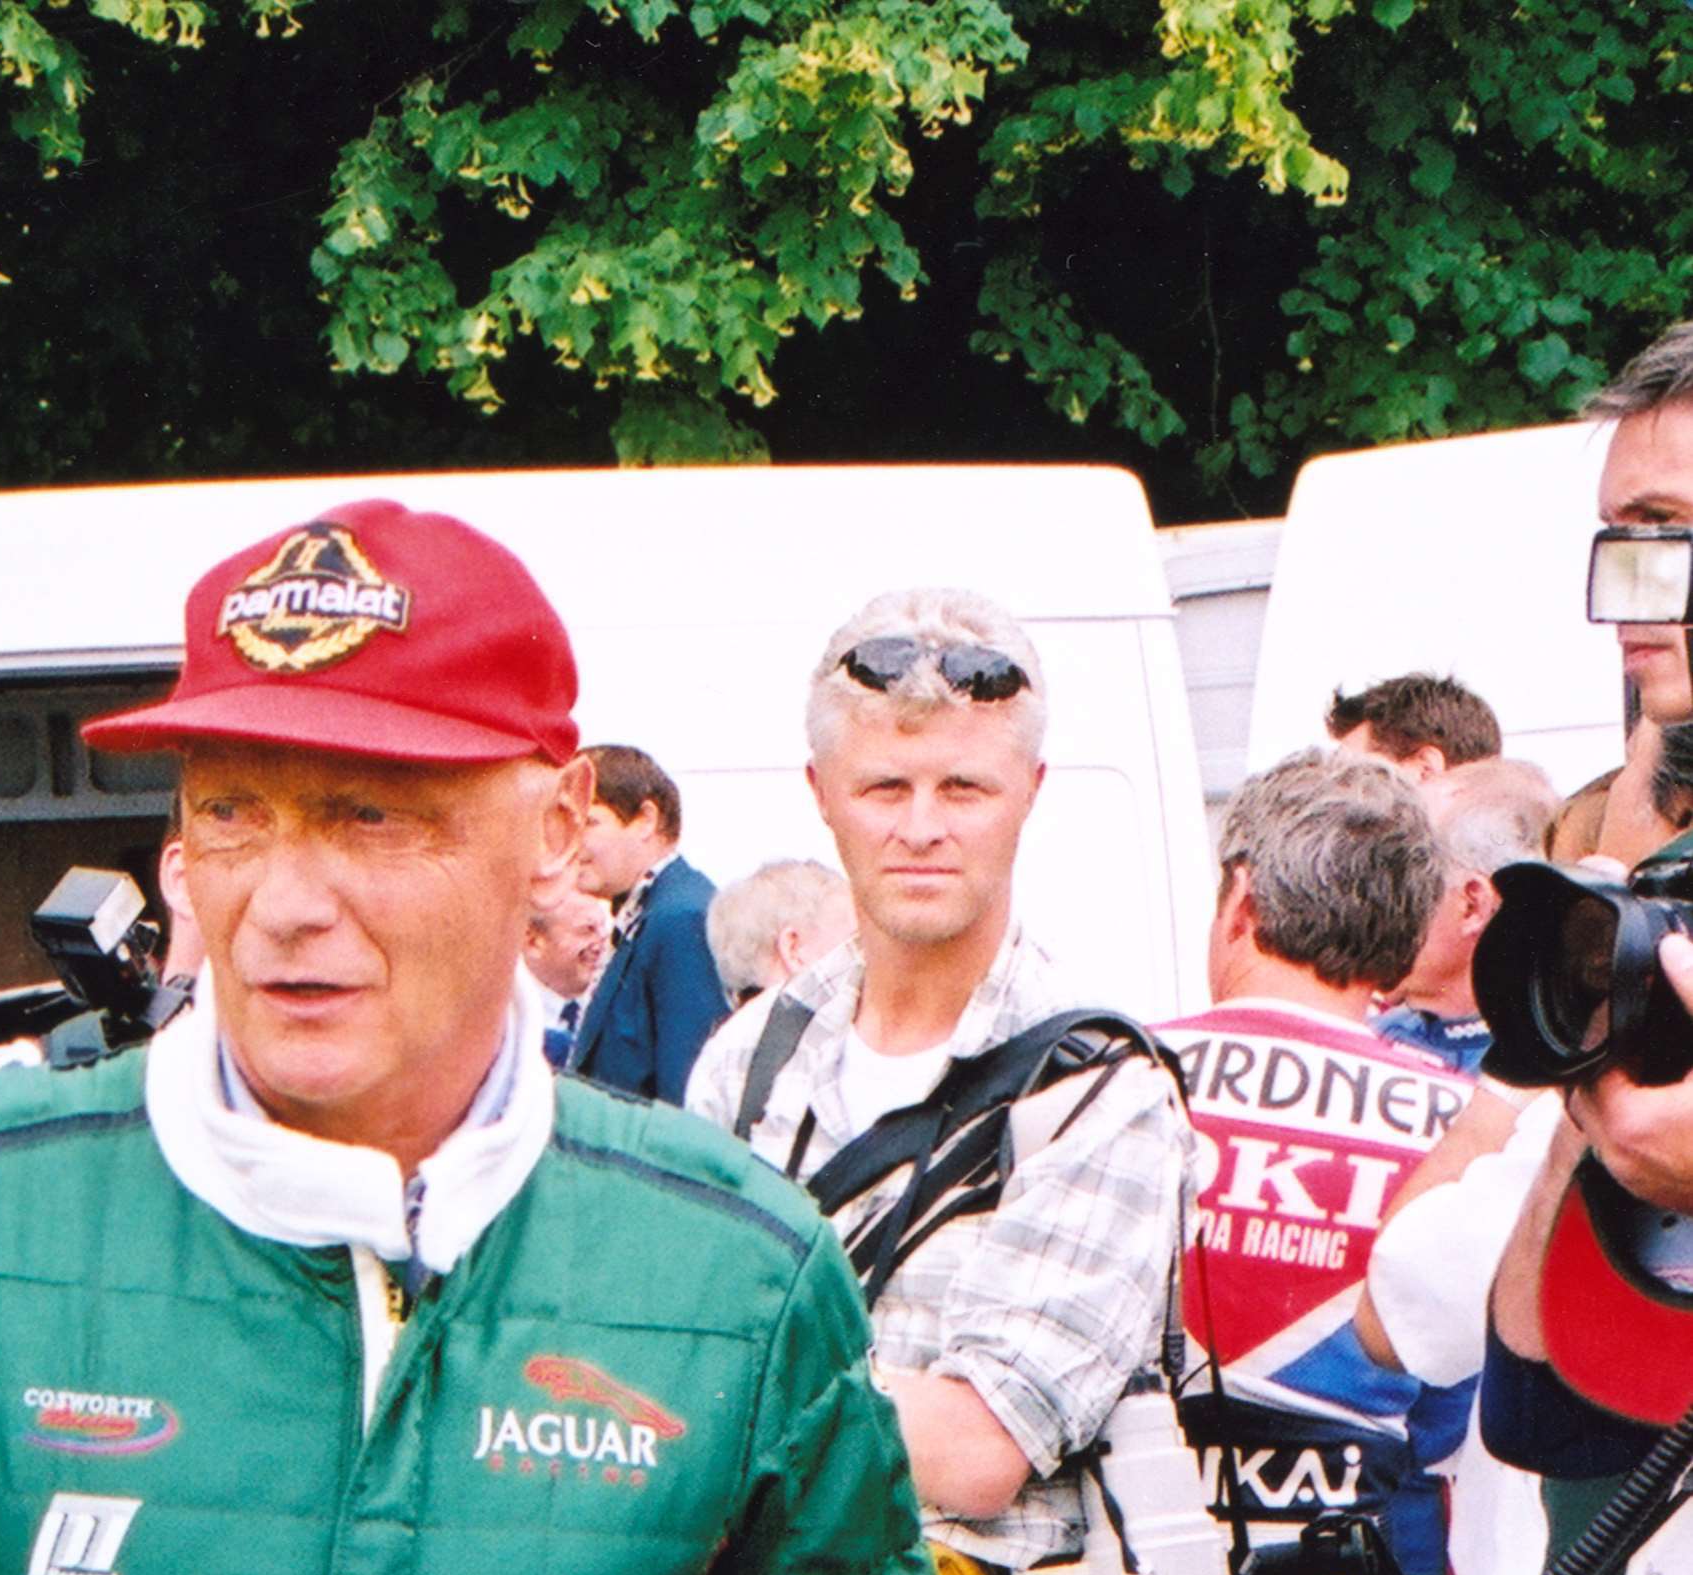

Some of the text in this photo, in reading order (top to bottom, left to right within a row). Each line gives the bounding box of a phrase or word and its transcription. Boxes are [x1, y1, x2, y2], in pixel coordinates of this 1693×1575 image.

[225, 578, 400, 622] parmalat
[1242, 1216, 1349, 1271] RACING
[23, 1387, 153, 1418] COSWORTH
[473, 1406, 658, 1467] JAGUAR
